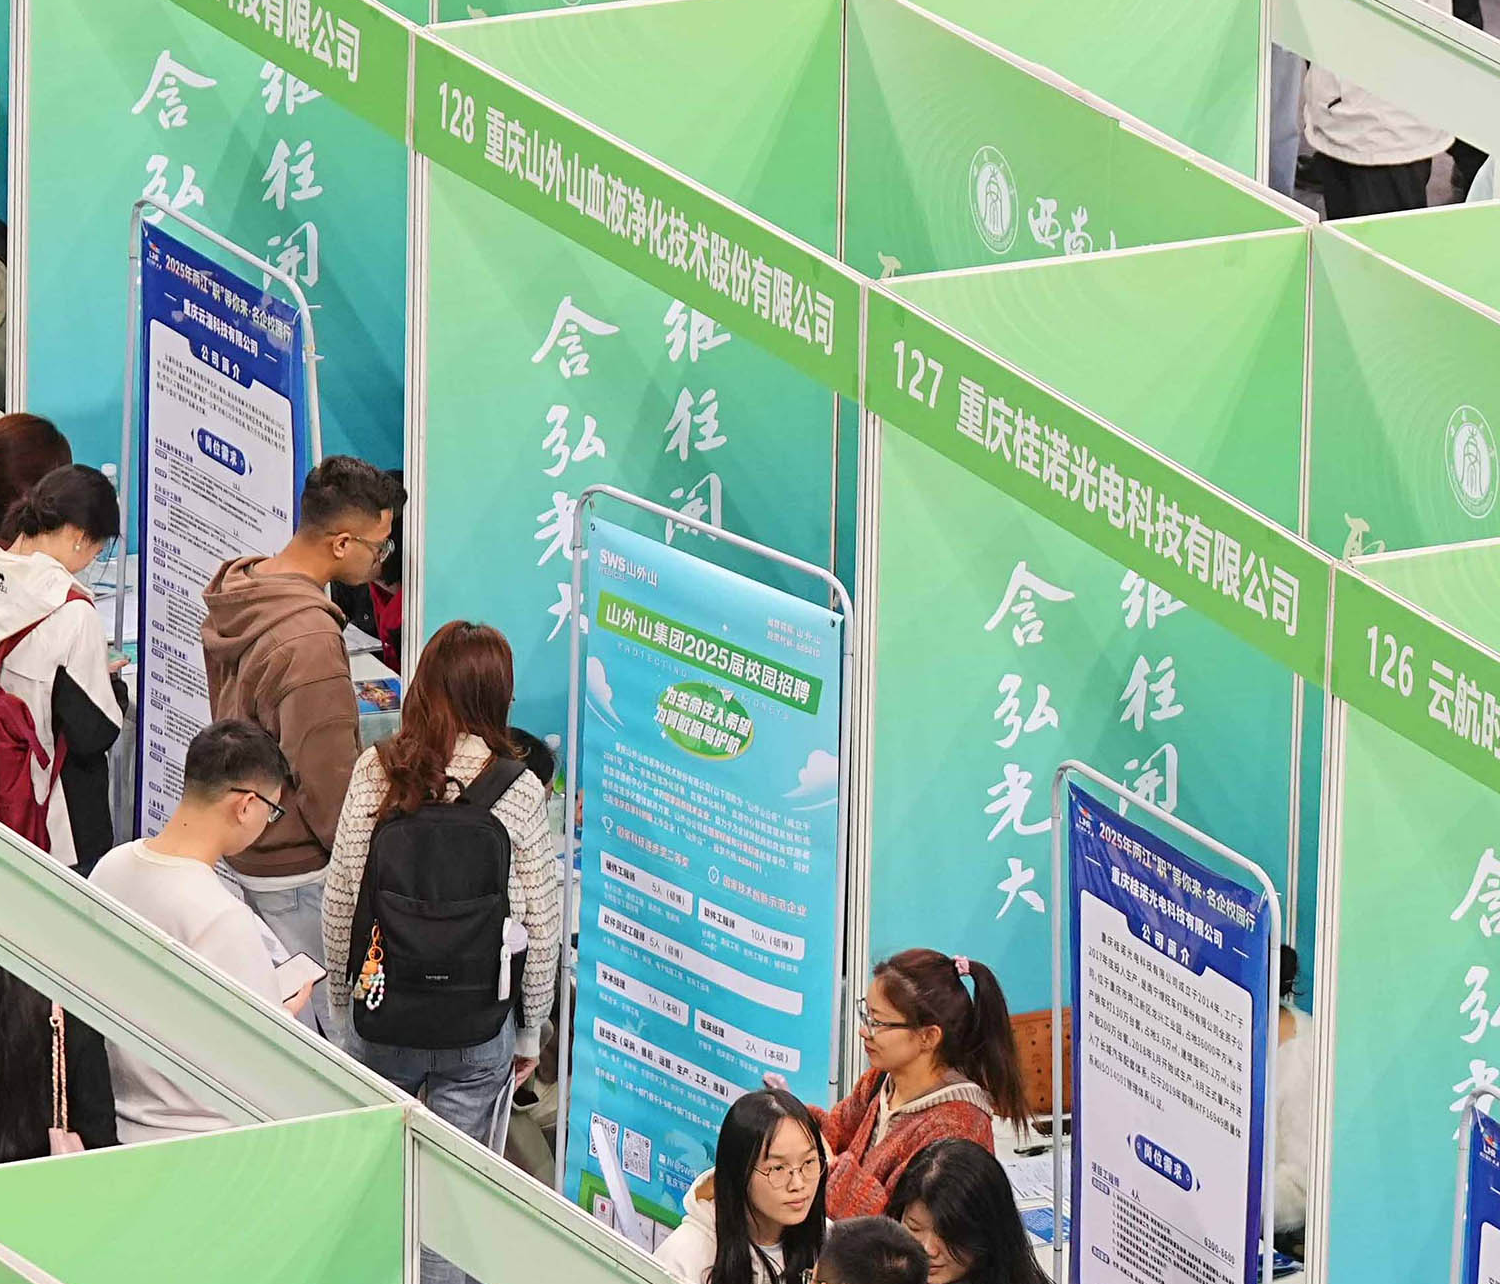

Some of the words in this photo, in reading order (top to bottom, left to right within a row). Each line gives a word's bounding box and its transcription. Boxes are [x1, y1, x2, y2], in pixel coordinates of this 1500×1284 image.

[440, 82, 476, 145] 128
[485, 109, 835, 354] 重庆山外山血液净化技术股份有限公司
[201, 345, 241, 381] 公司简介
[895, 341, 941, 408] 127
[958, 374, 1299, 636] 重庆桂诺光电科技有限公司
[600, 549, 626, 570] SWS
[626, 559, 658, 588] 山外山
[606, 602, 811, 705] 山外山集团2025届校园招聘
[1366, 625, 1414, 698] 126
[1111, 866, 1223, 949] 重庆桂诺光电科技有限公司
[1142, 923, 1190, 965] 公司简介
[1144, 1143, 1182, 1181] 岗位需求
